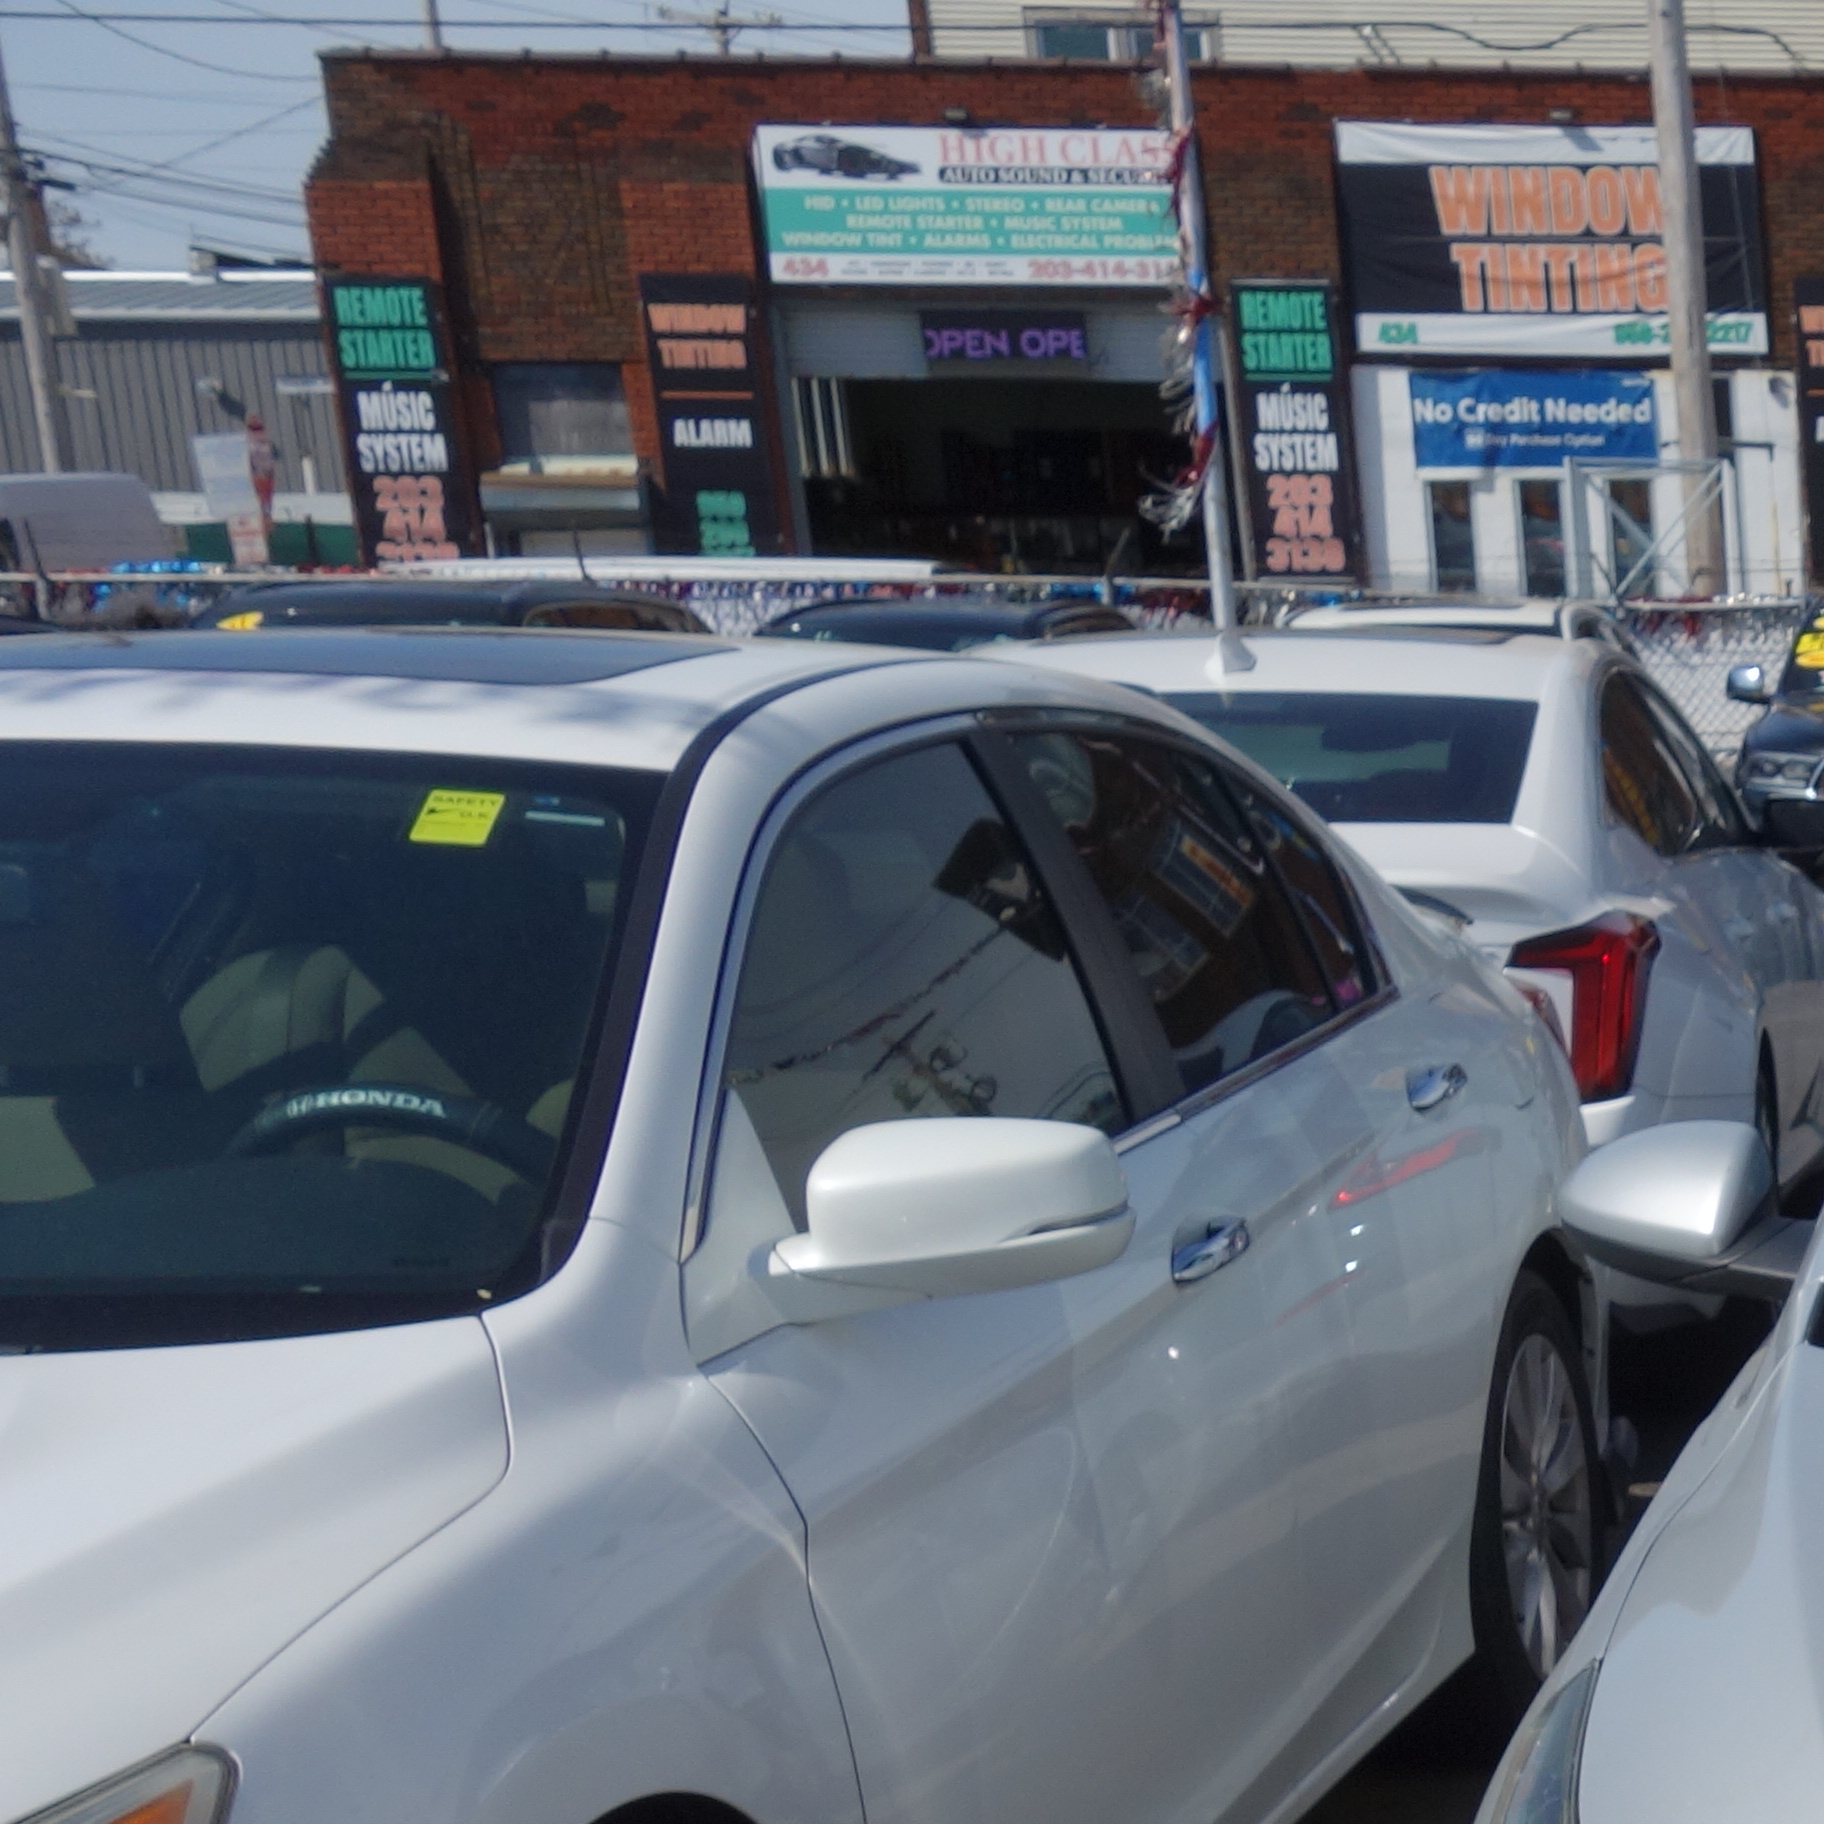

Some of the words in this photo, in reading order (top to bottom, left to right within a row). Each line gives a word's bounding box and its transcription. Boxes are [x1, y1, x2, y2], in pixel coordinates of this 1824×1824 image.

[939, 133, 1046, 164] HIGH
[944, 168, 994, 183] AUTO
[1001, 168, 1068, 183] SOUND
[1071, 168, 1084, 183] &
[856, 196, 884, 211] LED
[888, 197, 946, 212] LIGHTS
[965, 197, 1024, 212] STEREO
[1045, 198, 1087, 212] REAR
[1091, 199, 1160, 213] CAMERA
[1429, 166, 1664, 236] WINDOW
[846, 214, 912, 229] REMOTE
[916, 215, 983, 229] STARTER
[1003, 215, 1056, 230] MUSIC
[1060, 216, 1123, 230] SYSTEM
[782, 231, 862, 246] WINDOW
[866, 233, 903, 247] TINT
[924, 233, 991, 248] ALARMS
[1011, 234, 1098, 249] ELECTRICAL
[1029, 259, 1176, 279] 203-414-31
[1450, 242, 1670, 313] TINTING
[333, 286, 428, 326] REMOTE
[648, 303, 746, 334] WINDOW
[1239, 291, 1328, 330] REMOTE
[338, 328, 436, 369] STARTER
[656, 338, 748, 369] TINTING
[1241, 332, 1333, 371] STARTER
[1413, 398, 1453, 423] No
[1457, 396, 1540, 424] Credit
[1545, 397, 1651, 424] Needed
[673, 418, 753, 448] ALARM
[356, 433, 448, 473] SYSTEM
[1254, 432, 1339, 471] SYSTEM
[1267, 474, 1334, 509] 203
[316, 1089, 447, 1118] HONDA
